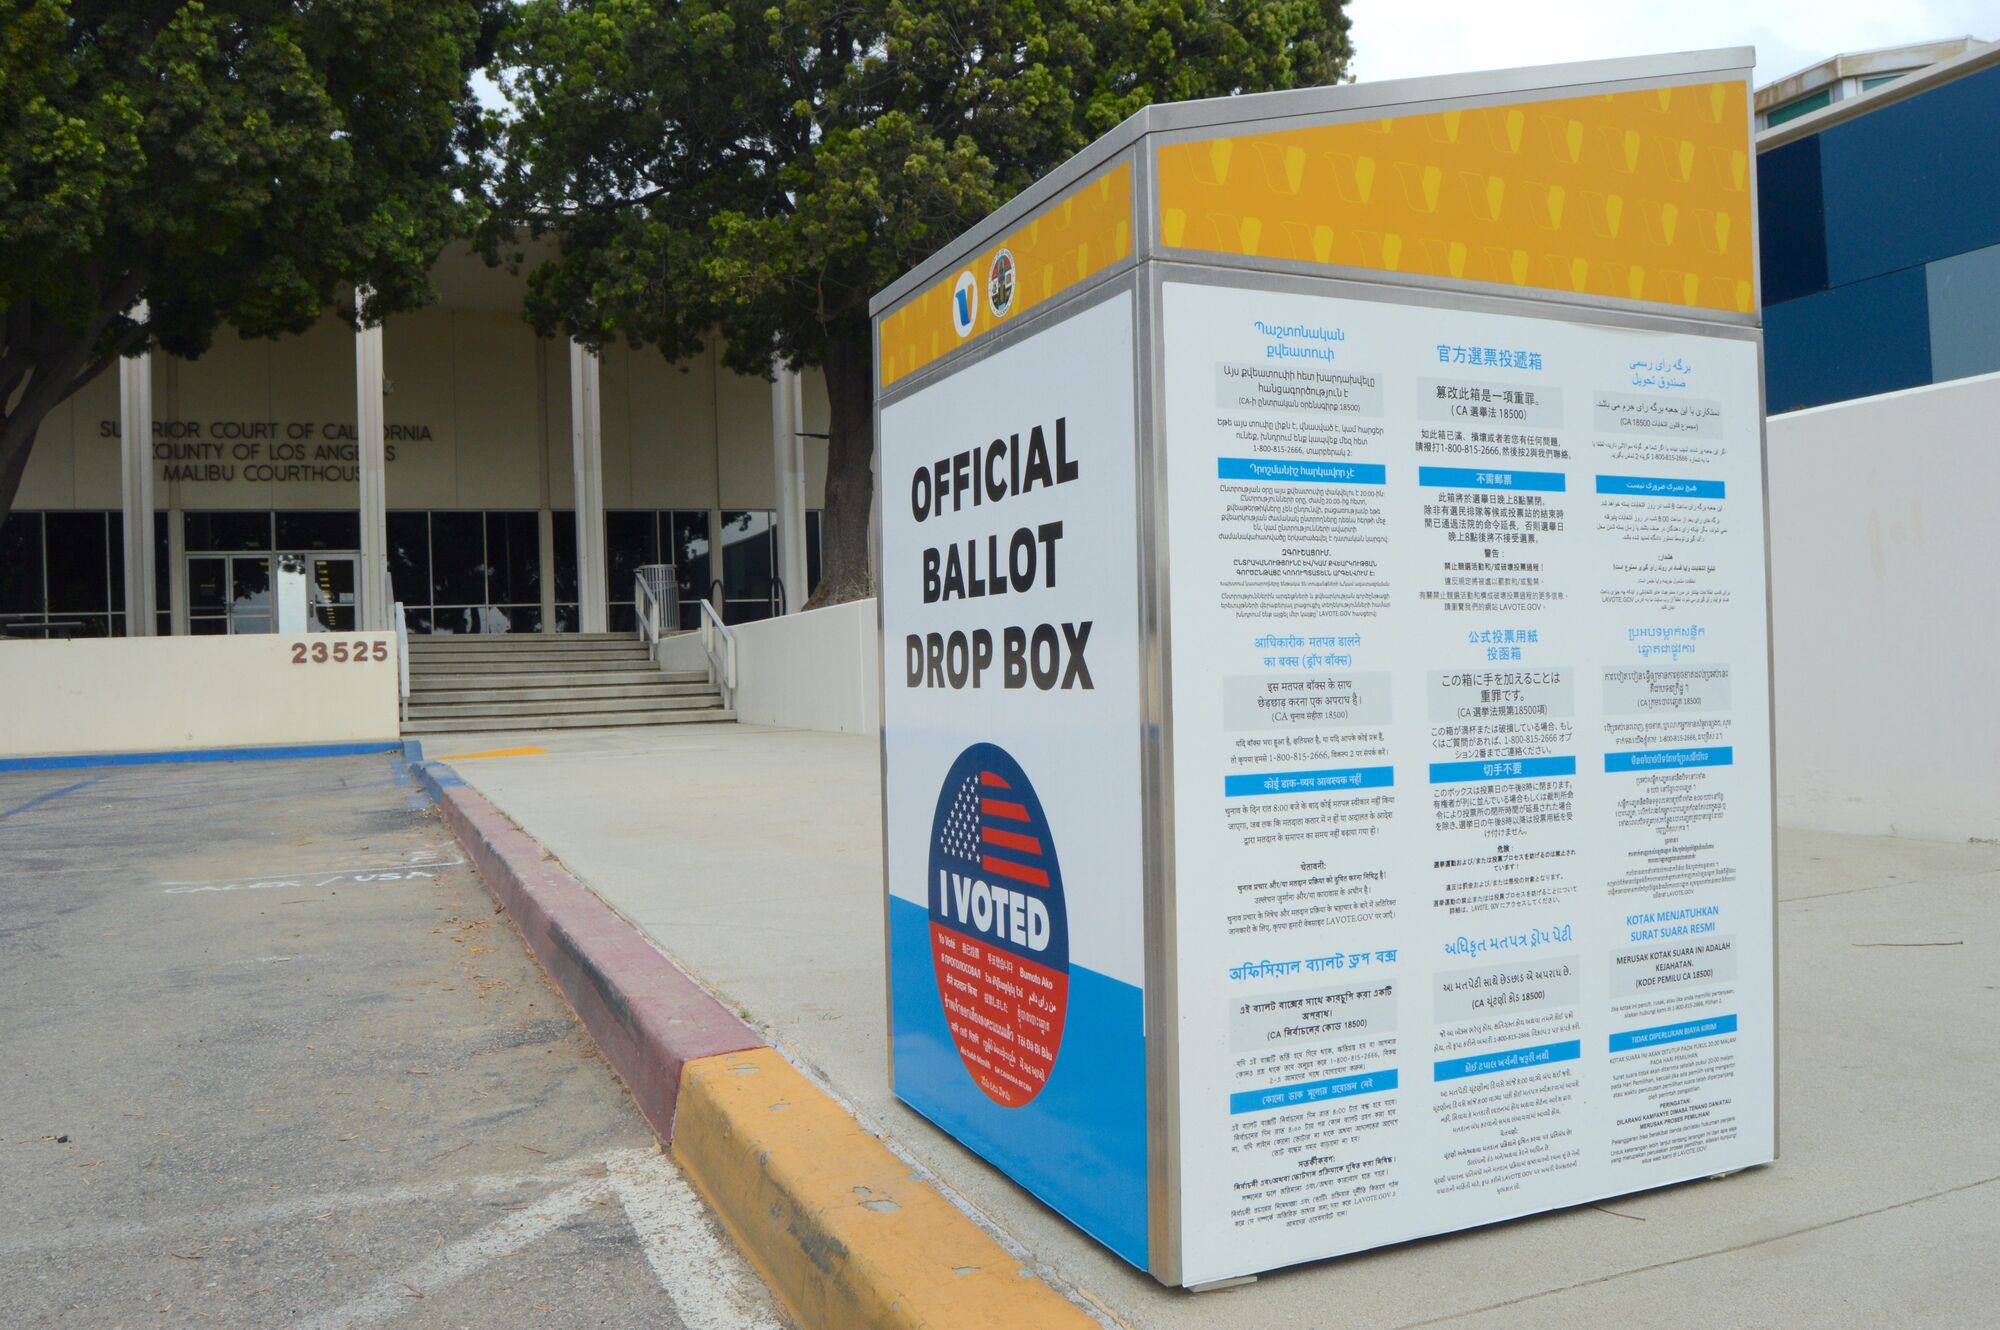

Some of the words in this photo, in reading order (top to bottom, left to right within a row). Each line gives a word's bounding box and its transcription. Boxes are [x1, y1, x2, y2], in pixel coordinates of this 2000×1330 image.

[1253, 321, 1344, 341] Պաշտոնական
[1436, 345, 1541, 369] 官方選票投遞箱
[1223, 365, 1239, 377] Այս
[1296, 370, 1314, 380] հետ
[1343, 388, 1348, 397] է
[1339, 403, 1360, 412] 18500)
[1499, 408, 1526, 419] 18500)
[100, 421, 200, 439] SURIOR
[210, 422, 278, 439] COURT
[287, 422, 314, 440] OF
[152, 442, 224, 460] OUNTY
[232, 443, 260, 461] OF
[269, 443, 305, 461] LOS
[163, 464, 234, 482] MALIBU
[911, 416, 1079, 522] OFFICIAL
[923, 520, 1063, 604] BALLOT
[1468, 629, 1538, 643] 公式投票用紙
[291, 640, 388, 664] 23525
[906, 628, 993, 690] DROP
[1003, 621, 1095, 691] BOX
[1487, 646, 1520, 660] 投函箱
[1263, 656, 1276, 666] का
[1266, 682, 1279, 693] इस
[1327, 677, 1335, 688] के
[1336, 680, 1352, 689] साथ
[1441, 672, 1560, 686] この箱に手を加えることは
[1287, 697, 1307, 706] करना
[1309, 696, 1322, 707] एक
[1325, 696, 1350, 706] अपराध
[1480, 689, 1524, 702] 重罪です。
[1483, 762, 1521, 775] 切手不要
[1263, 777, 1280, 790] कोई
[1348, 772, 1361, 785] नहीं
[355, 871, 435, 882] USA
[940, 869, 948, 917] I
[952, 873, 1050, 951] VOTED
[1626, 913, 1654, 925] KOTAK
[1656, 906, 1718, 921] MENJATUHKAN
[1630, 928, 1658, 941] SURAT
[1660, 925, 1688, 937] SUARA
[1690, 922, 1715, 933] RESMI
[1616, 953, 1648, 964] MERUSAK
[1649, 950, 1671, 959] KOTAK
[1672, 947, 1694, 957] SUARA
[1705, 942, 1730, 951] ADALAH
[1655, 959, 1693, 971] KEJAHATAN.
[1635, 977, 1655, 988] (KODE
[1657, 973, 1681, 983] PEMILU
[1682, 972, 1691, 980] CA
[1692, 968, 1713, 978] 18500)
[1443, 983, 1453, 991] આ
[1471, 999, 1484, 1009] (CA
[1521, 990, 1545, 1001] 18500)
[1239, 1003, 1250, 1014] এই
[1266, 1030, 1281, 1040] (CA
[1344, 1018, 1367, 1028] 18500)
[1649, 1030, 1684, 1041] DIPERLUKAN
[1684, 1027, 1700, 1035] BIAYA
